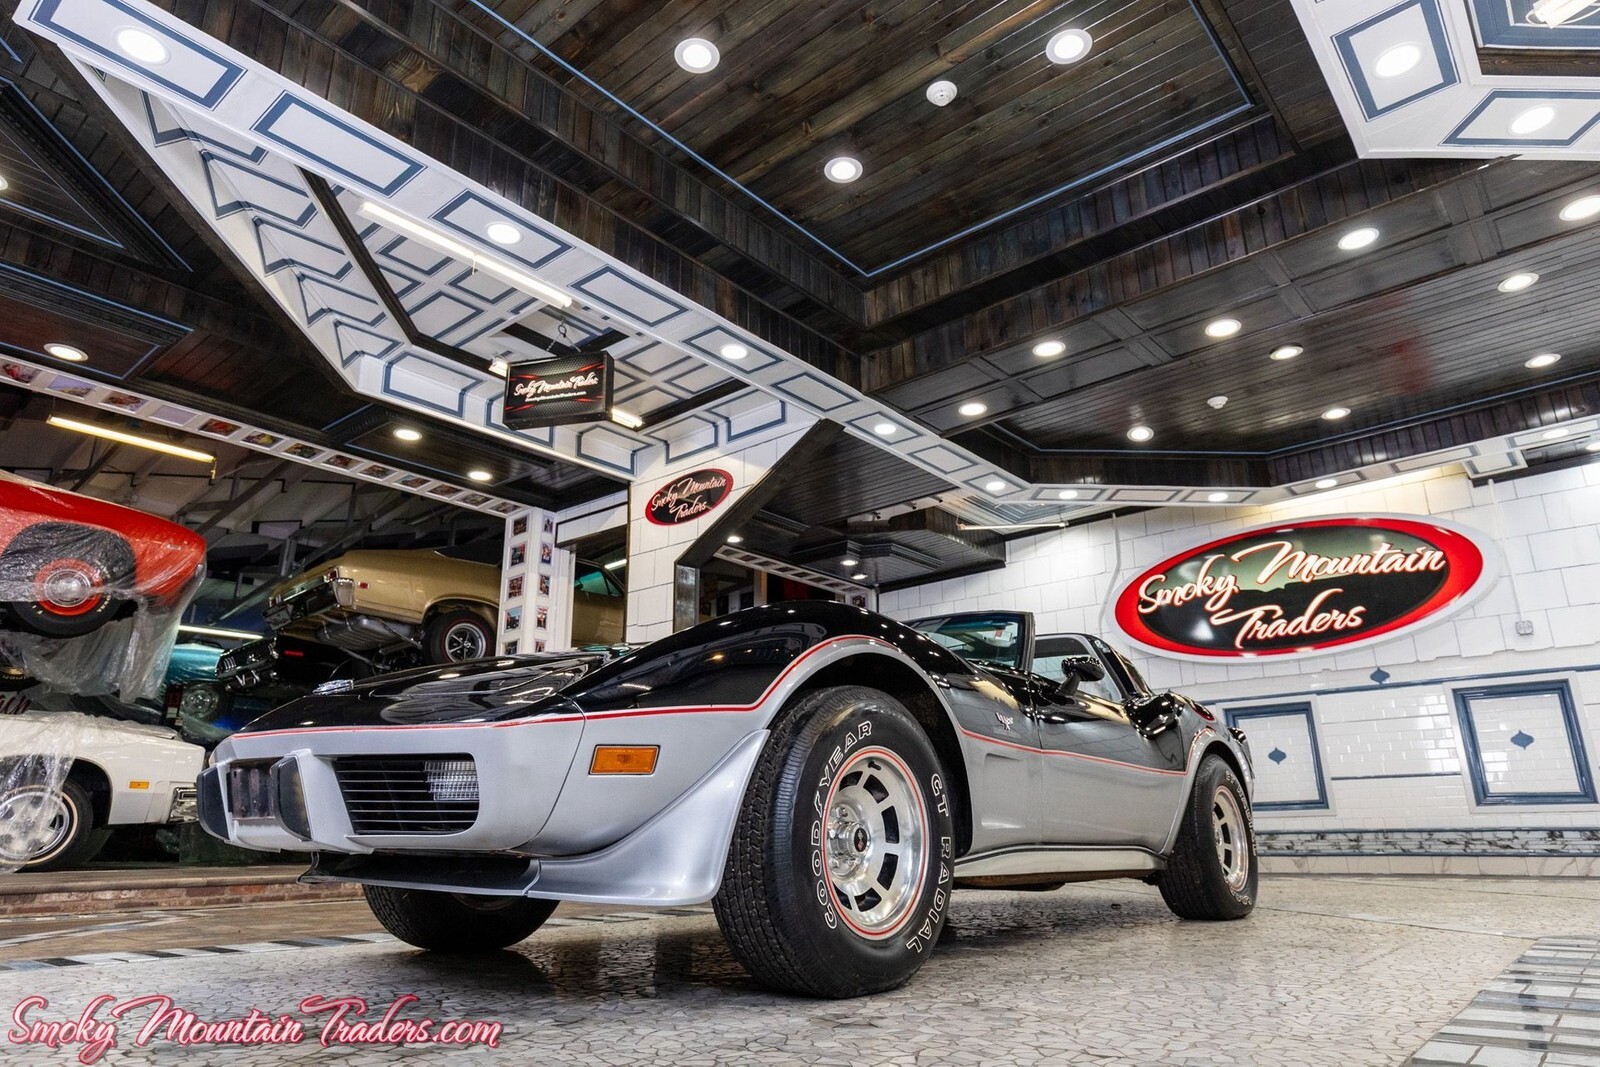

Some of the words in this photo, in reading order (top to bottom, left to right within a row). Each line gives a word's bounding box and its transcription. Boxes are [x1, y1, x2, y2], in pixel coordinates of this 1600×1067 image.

[651, 484, 678, 511] Smoky
[677, 476, 726, 494] Mountain
[669, 495, 707, 522] Traders
[1137, 554, 1239, 614] Smoky
[1231, 540, 1447, 585] Mountain
[1210, 588, 1367, 649] Traders
[811, 720, 872, 930] GOODYEAR
[930, 773, 949, 817] GT
[906, 836, 951, 954] RADIAL
